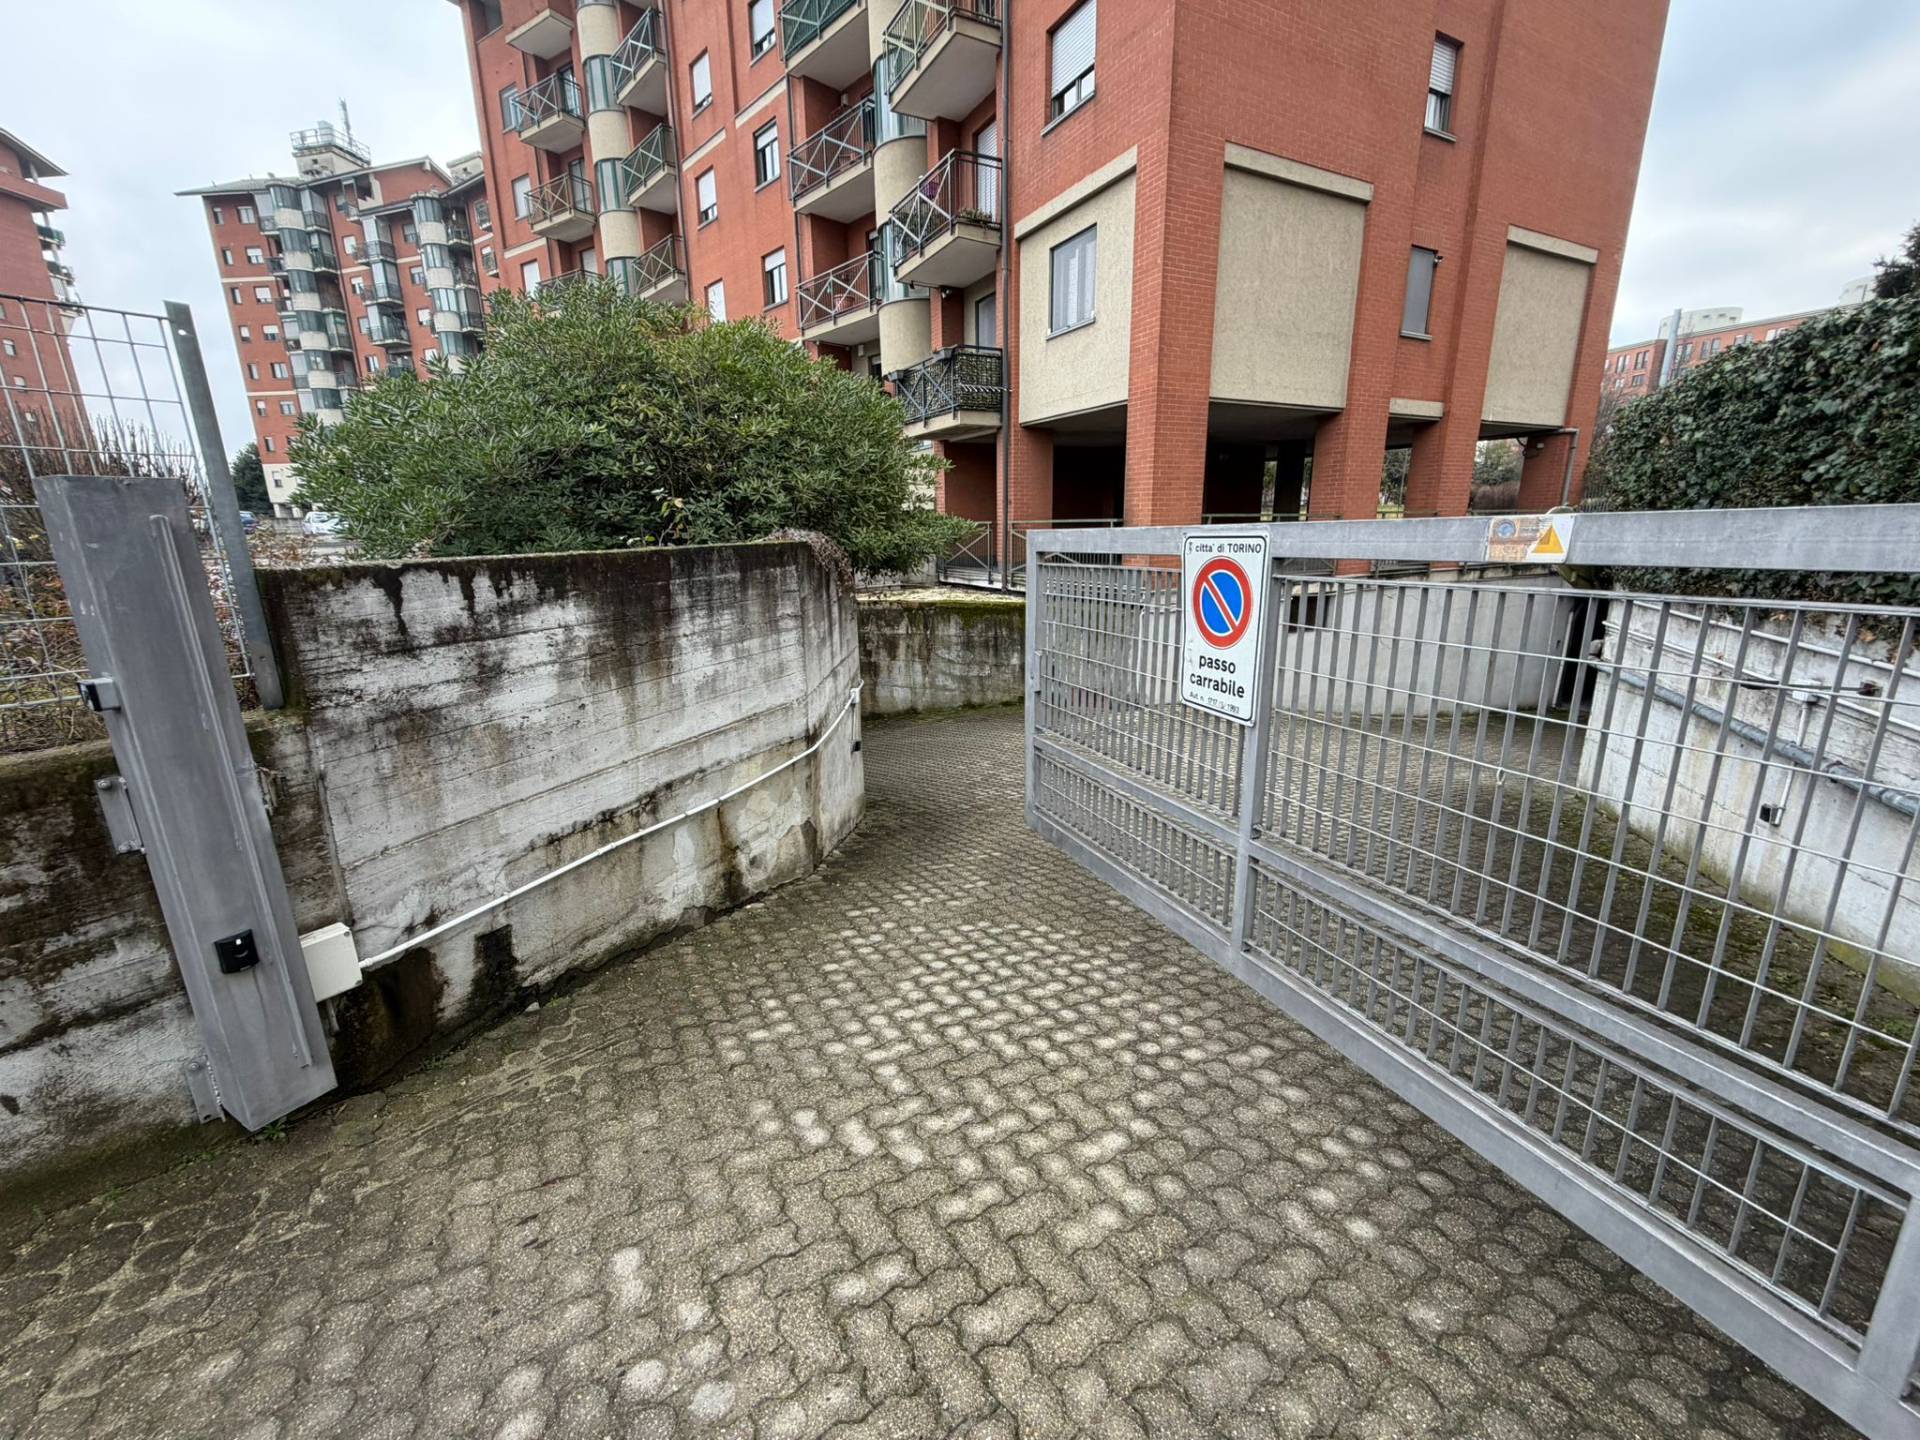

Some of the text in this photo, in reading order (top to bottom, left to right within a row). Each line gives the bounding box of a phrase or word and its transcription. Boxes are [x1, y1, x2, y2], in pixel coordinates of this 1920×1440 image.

[1217, 543, 1225, 553] di
[1227, 543, 1262, 553] TORINO
[1199, 655, 1236, 674] passo
[1190, 673, 1245, 699] carrabile
